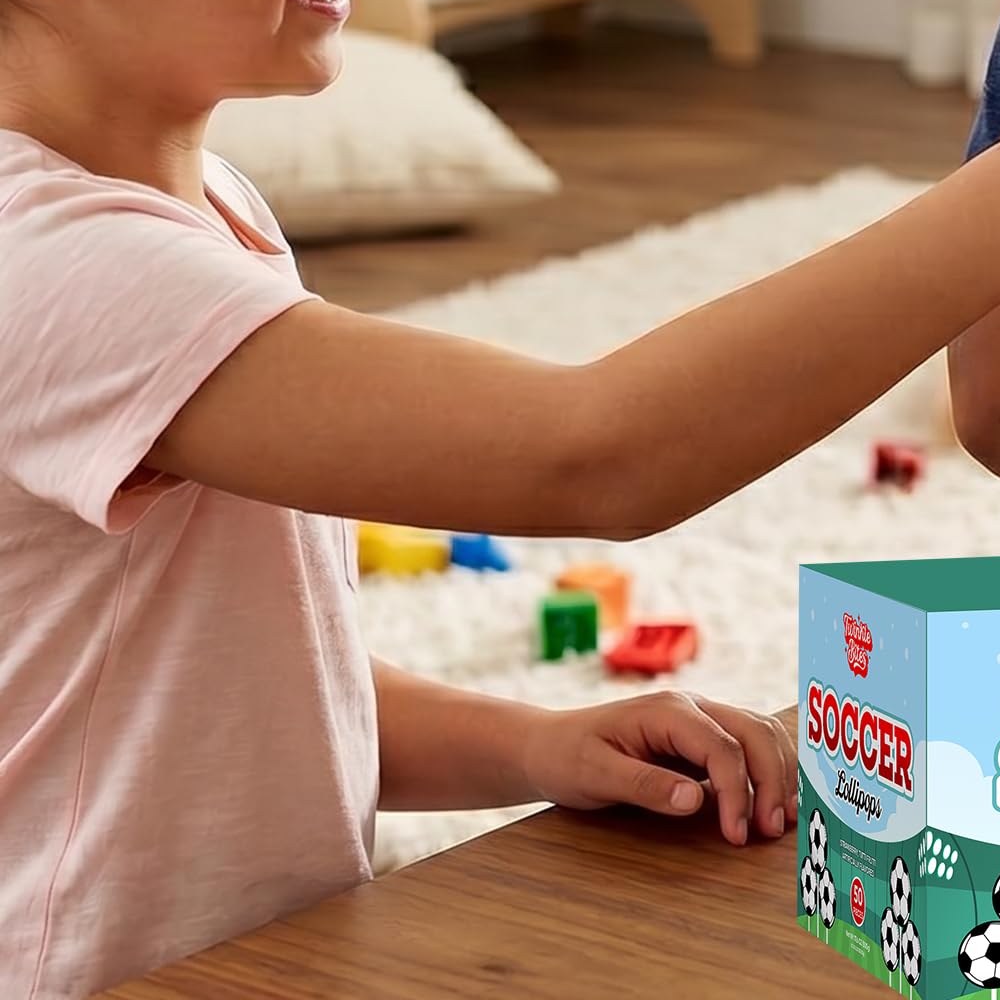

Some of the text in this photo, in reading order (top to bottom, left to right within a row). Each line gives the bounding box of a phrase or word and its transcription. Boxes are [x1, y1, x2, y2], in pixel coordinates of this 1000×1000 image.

[844, 613, 871, 645] Twinkle
[848, 638, 868, 670] Bites
[808, 685, 913, 792] SOCCER
[834, 769, 883, 822] Lollipops
[853, 884, 863, 906] 50
